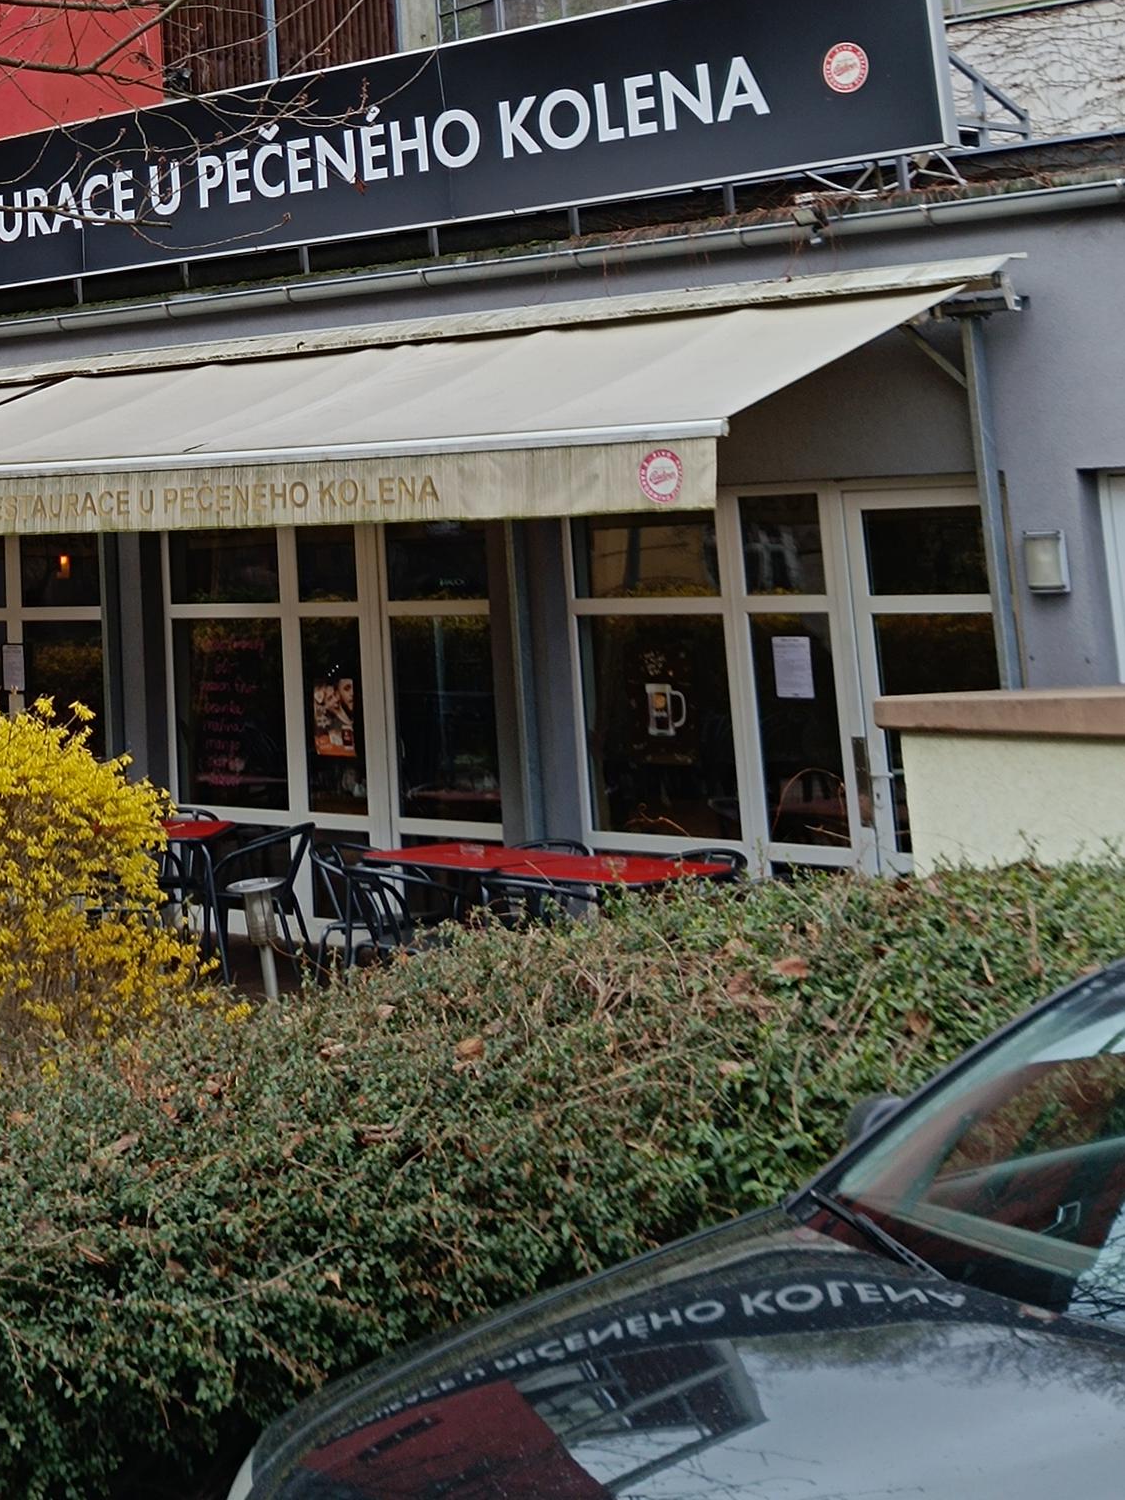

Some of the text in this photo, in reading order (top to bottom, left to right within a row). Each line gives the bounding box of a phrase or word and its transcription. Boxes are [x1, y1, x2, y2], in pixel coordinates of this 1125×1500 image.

[149, 159, 182, 216] U
[199, 105, 481, 209] PEČENÉHO
[497, 55, 771, 160] KOLENA
[139, 488, 154, 515] U
[319, 475, 440, 507] KOLENA
